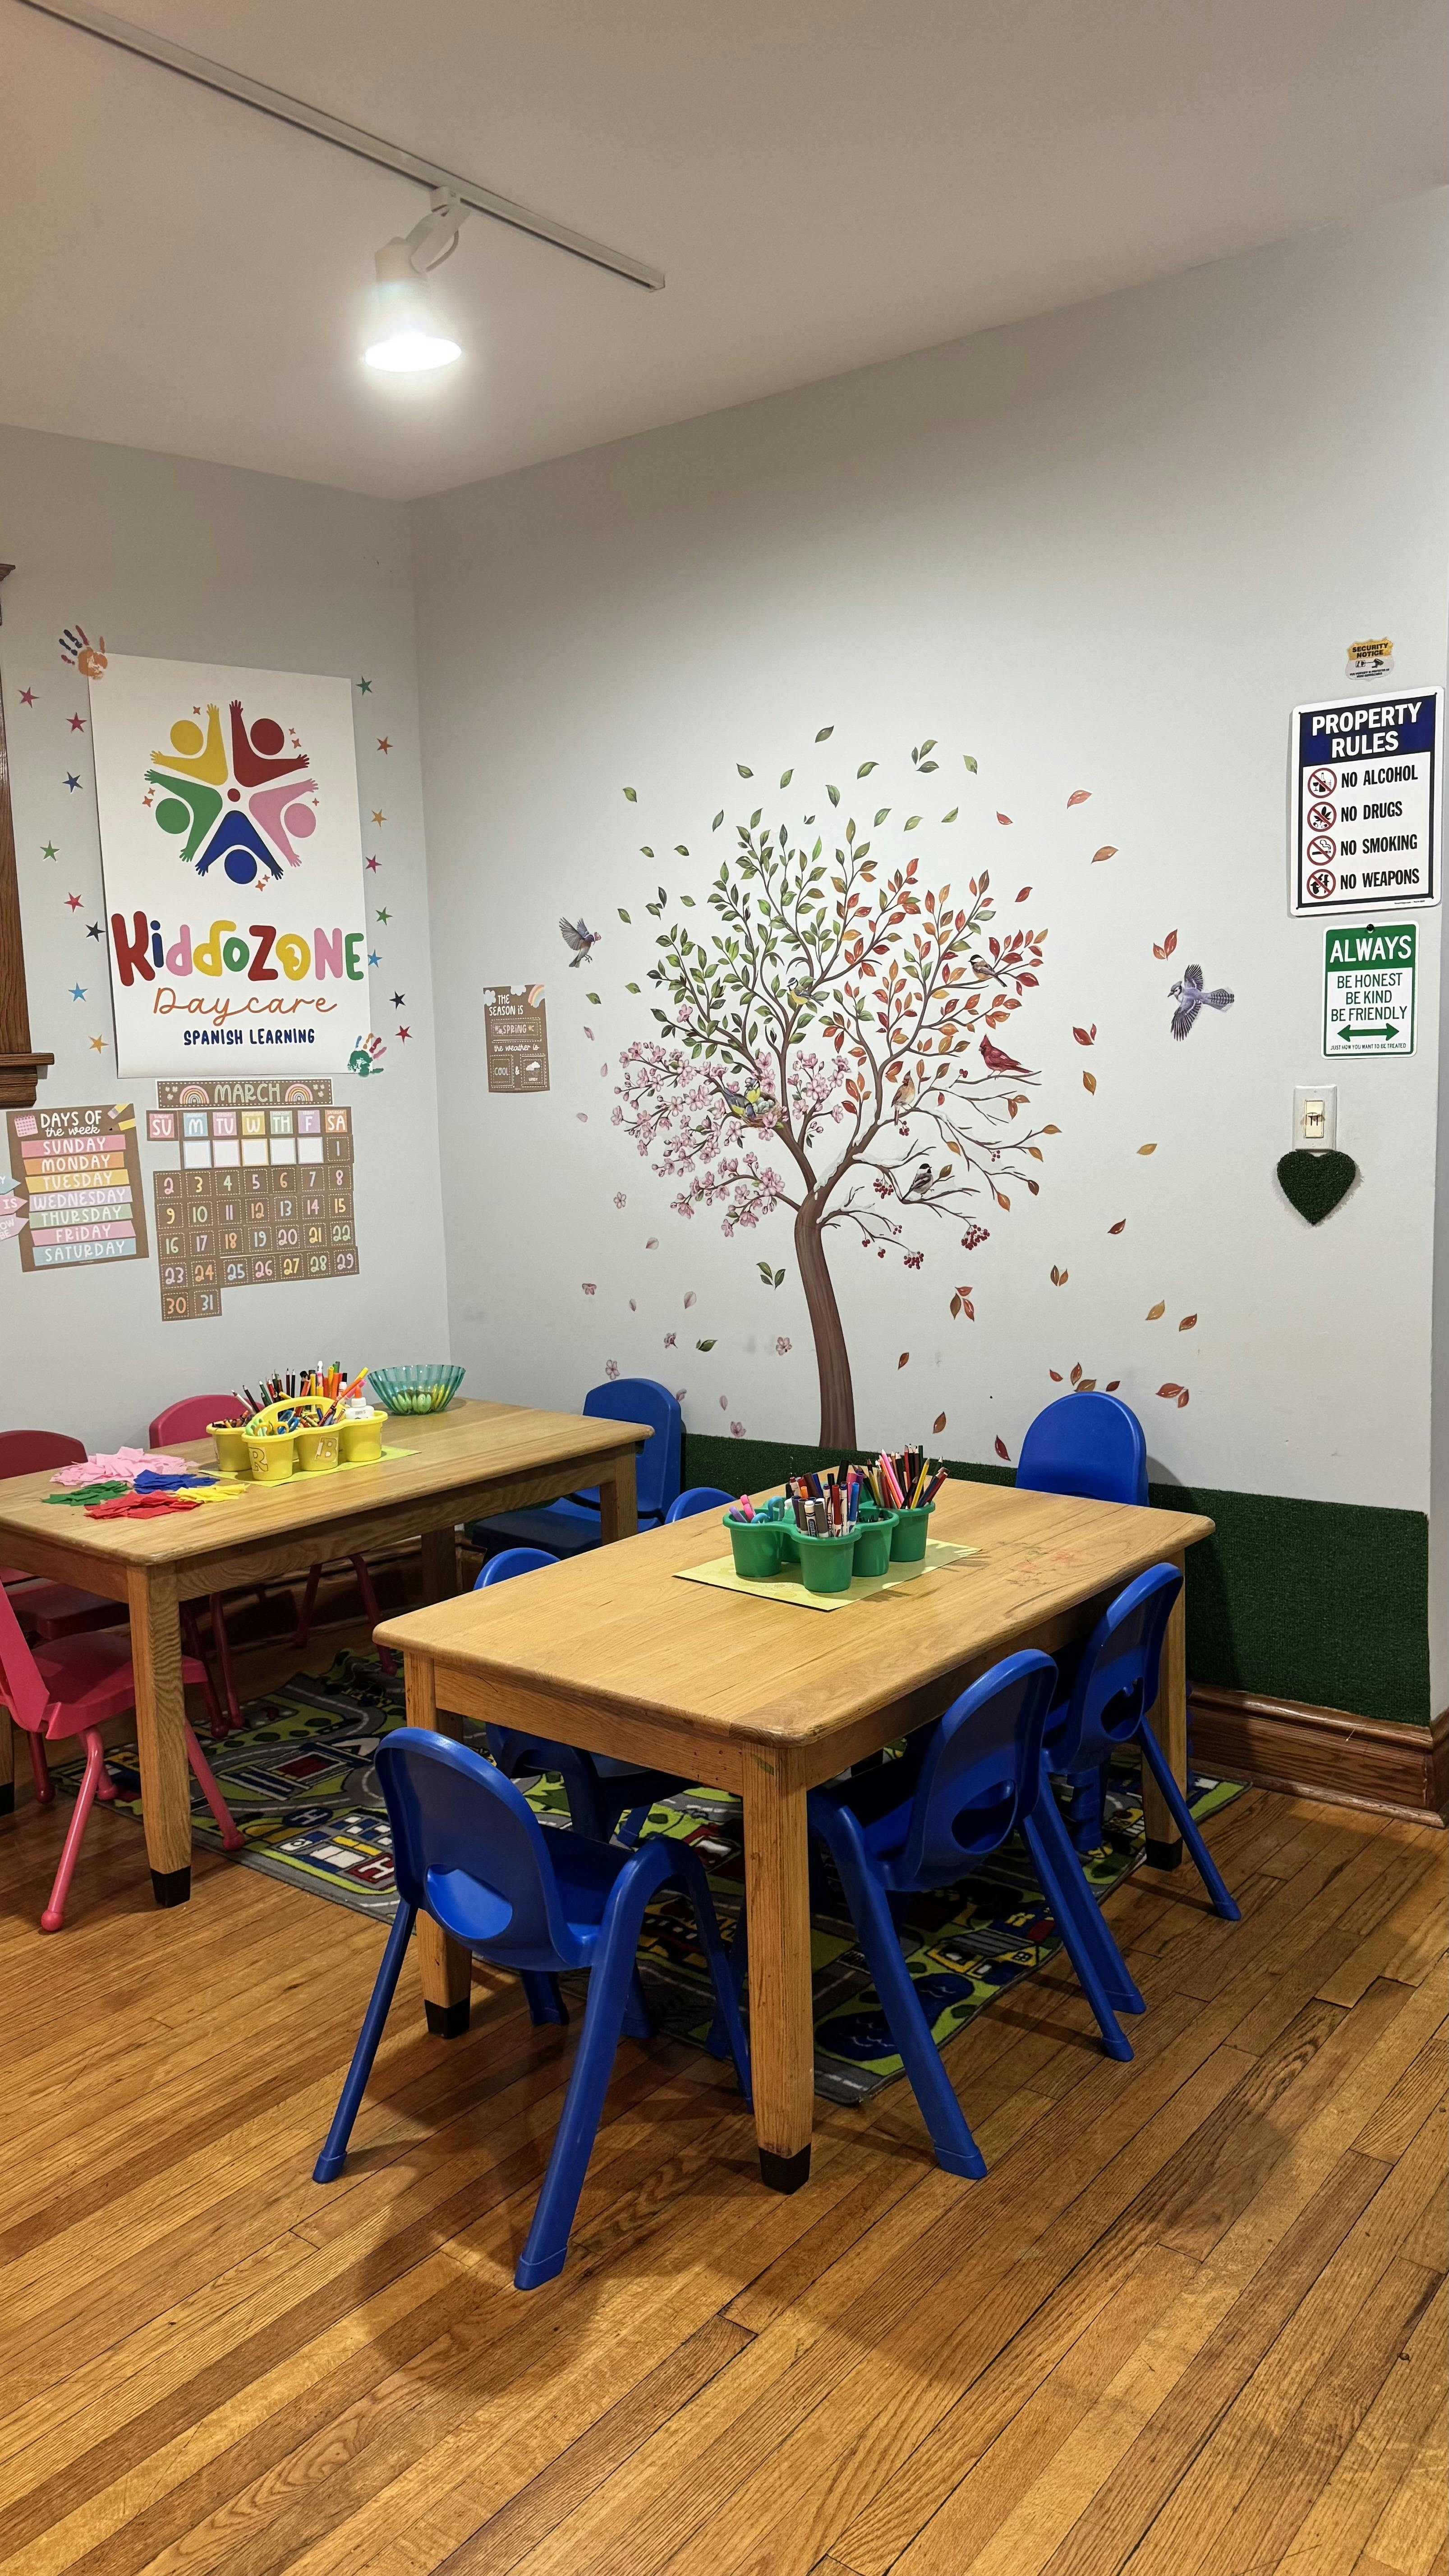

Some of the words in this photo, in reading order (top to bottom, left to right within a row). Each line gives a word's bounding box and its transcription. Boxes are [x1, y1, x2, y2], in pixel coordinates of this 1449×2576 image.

[1352, 643, 1388, 652] SECURITY
[1357, 650, 1384, 658] NOTICE
[1312, 702, 1422, 736] PROPERTY
[1331, 731, 1399, 758] RULES
[1341, 772, 1357, 788] NO
[1363, 764, 1418, 786] ALCOHOL
[1341, 806, 1357, 822] NO
[1363, 801, 1403, 820] DRUGS
[1340, 840, 1357, 856] NO
[1362, 834, 1417, 854] SMOKING
[1340, 874, 1357, 890] NO
[1362, 868, 1420, 888] WEAPONS
[1329, 935, 1412, 963] ALWAYS
[1337, 975, 1352, 989] BE
[1355, 973, 1403, 988] HONEST
[153, 987, 337, 1026] Daycare
[498, 994, 510, 1004] THE
[1346, 991, 1361, 1005] BE
[1364, 990, 1392, 1004] KIND
[489, 1006, 515, 1016] SEASON
[1331, 1008, 1346, 1022] BE
[1349, 1006, 1407, 1021] FRIENDLY
[184, 1028, 244, 1046] SPANISH
[249, 1027, 316, 1045] LEARNING
[515, 1066, 520, 1075] &
[215, 1083, 280, 1103] MARCH
[41, 1111, 78, 1128] DAYS
[85, 1110, 102, 1125] OF
[152, 1118, 172, 1136] SU
[189, 1118, 203, 1135] M
[216, 1118, 234, 1134] TU
[246, 1117, 260, 1133] W
[273, 1117, 290, 1132] TH
[305, 1116, 313, 1132] F
[327, 1115, 345, 1131] SA
[46, 1127, 64, 1137] the
[69, 1125, 100, 1135] week
[43, 1137, 106, 1155] SUNDAY
[336, 1141, 340, 1156] 1
[42, 1155, 110, 1173] MONDAY
[43, 1172, 112, 1190] TUESDAY
[164, 1177, 174, 1195] 2
[194, 1177, 203, 1193] 3
[224, 1176, 232, 1191] 4
[252, 1174, 260, 1190] 5
[280, 1173, 287, 1188] 6
[309, 1171, 316, 1187] 7
[336, 1170, 344, 1185] 8
[3, 1198, 18, 1209] IS
[33, 1188, 125, 1209] WEDNESDAY
[41, 1206, 121, 1226] THURSDAY
[166, 1208, 175, 1224] 9
[193, 1205, 208, 1223] 10
[226, 1205, 233, 1220] 11
[251, 1202, 264, 1219] 12
[280, 1201, 292, 1217] 13
[307, 1199, 319, 1214] 14
[334, 1198, 346, 1213] 15
[166, 1237, 179, 1254] 16
[197, 1235, 207, 1251] 17
[225, 1233, 237, 1249] 18
[254, 1231, 267, 1247] 19
[278, 1229, 298, 1246] 20
[309, 1227, 322, 1243] 21
[333, 1225, 351, 1242] 22
[45, 1241, 125, 1262] SATURDAY
[165, 1268, 184, 1285] 23
[194, 1264, 213, 1282] 24
[227, 1264, 245, 1280] 25
[255, 1260, 273, 1278] 26
[283, 1258, 299, 1275] 27
[310, 1256, 327, 1272] 28
[336, 1253, 354, 1270] 29
[166, 1297, 186, 1314] 30
[200, 1295, 213, 1311] 31
[249, 1447, 268, 1472] R
[315, 1437, 338, 1462] B
